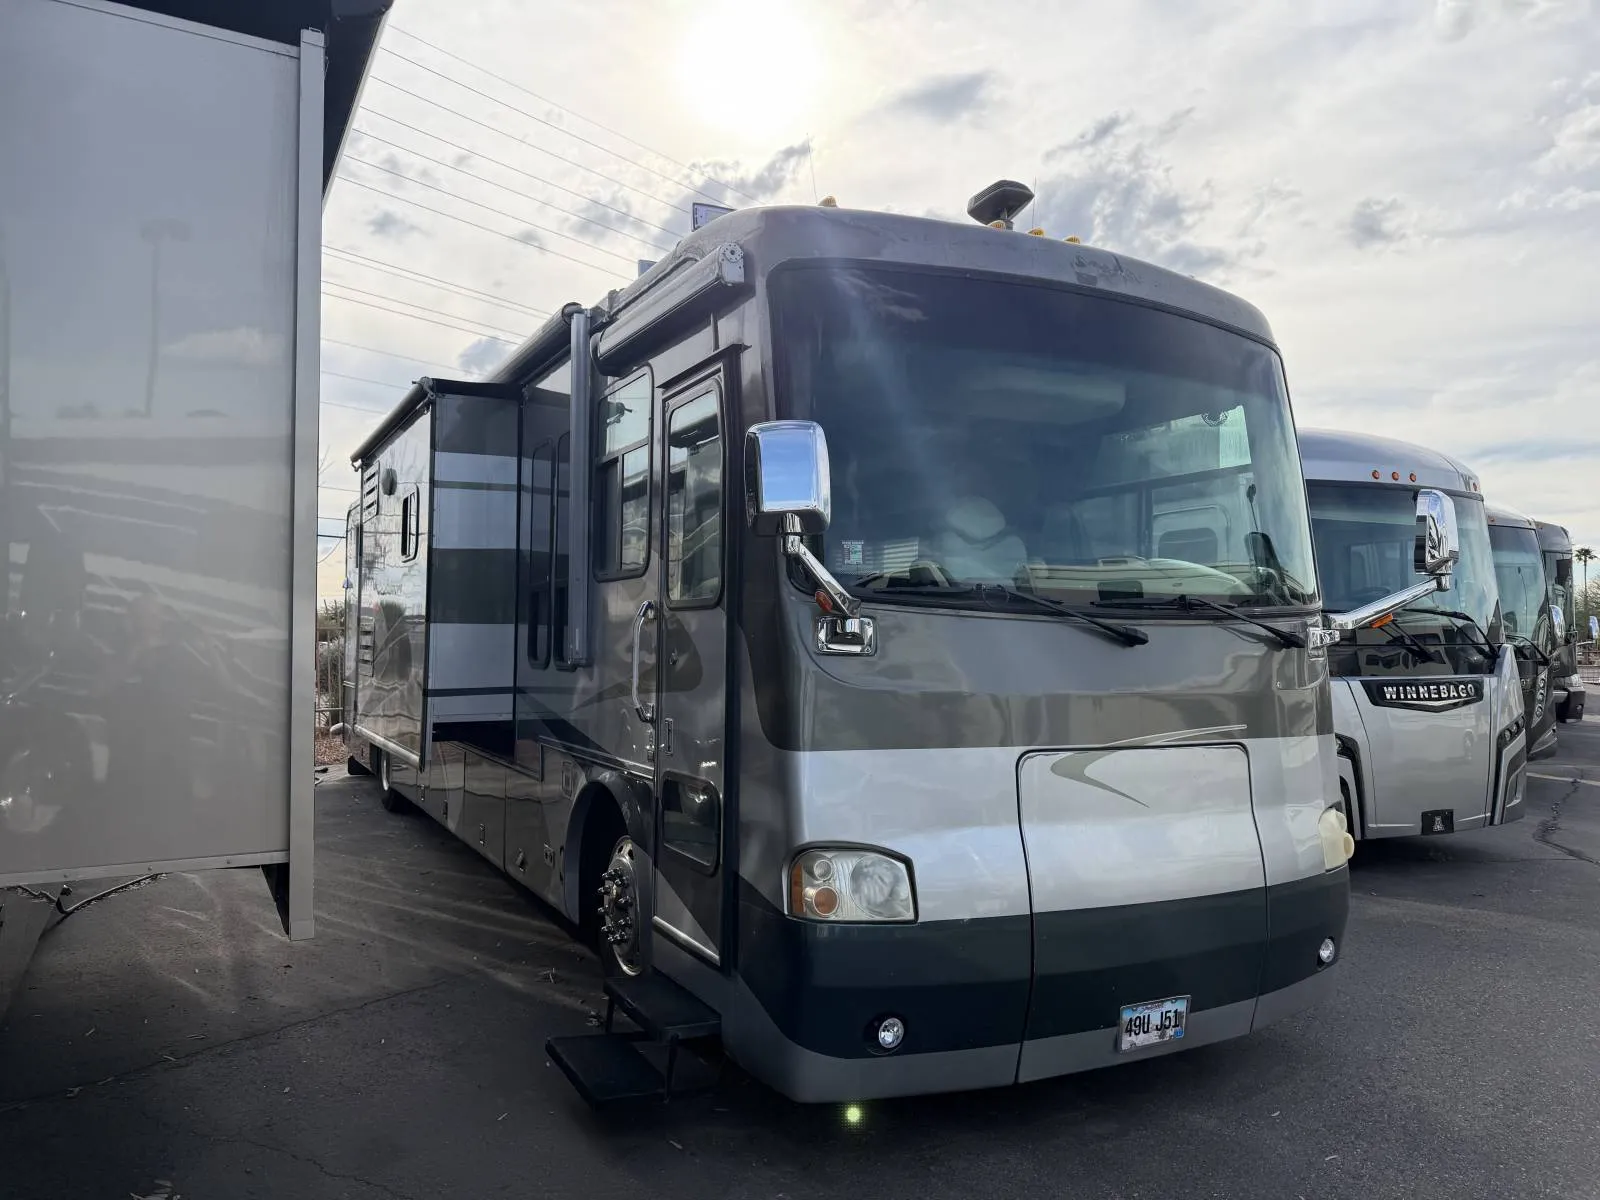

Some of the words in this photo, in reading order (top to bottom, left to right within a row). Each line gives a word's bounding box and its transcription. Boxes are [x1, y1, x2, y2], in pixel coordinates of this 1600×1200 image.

[1383, 683, 1475, 700] WINNEBAGO
[1125, 1014, 1151, 1037] 49U
[1155, 1008, 1180, 1032] J51
